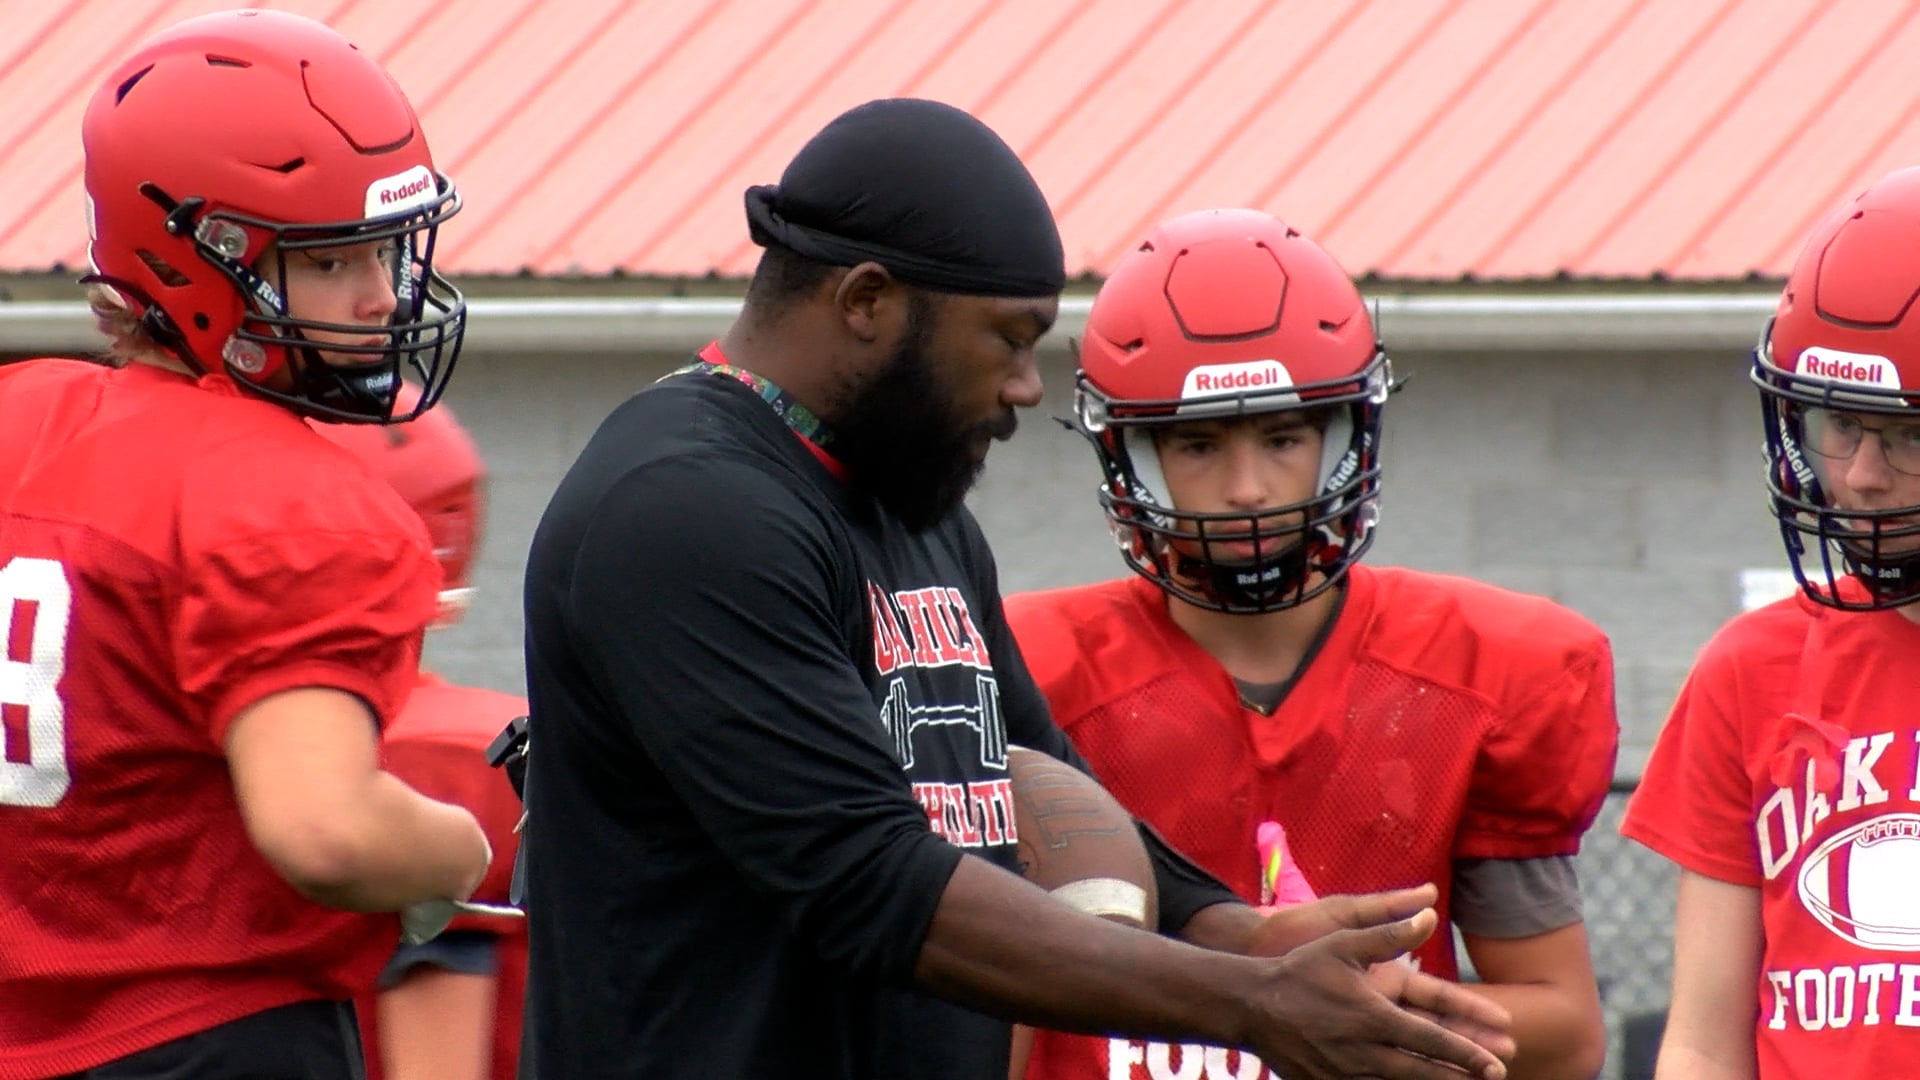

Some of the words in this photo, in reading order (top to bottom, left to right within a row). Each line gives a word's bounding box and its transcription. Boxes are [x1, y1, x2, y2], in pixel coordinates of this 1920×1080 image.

[380, 174, 431, 205] Riddell
[1195, 367, 1279, 391] Riddell
[1806, 354, 1883, 383] Riddell
